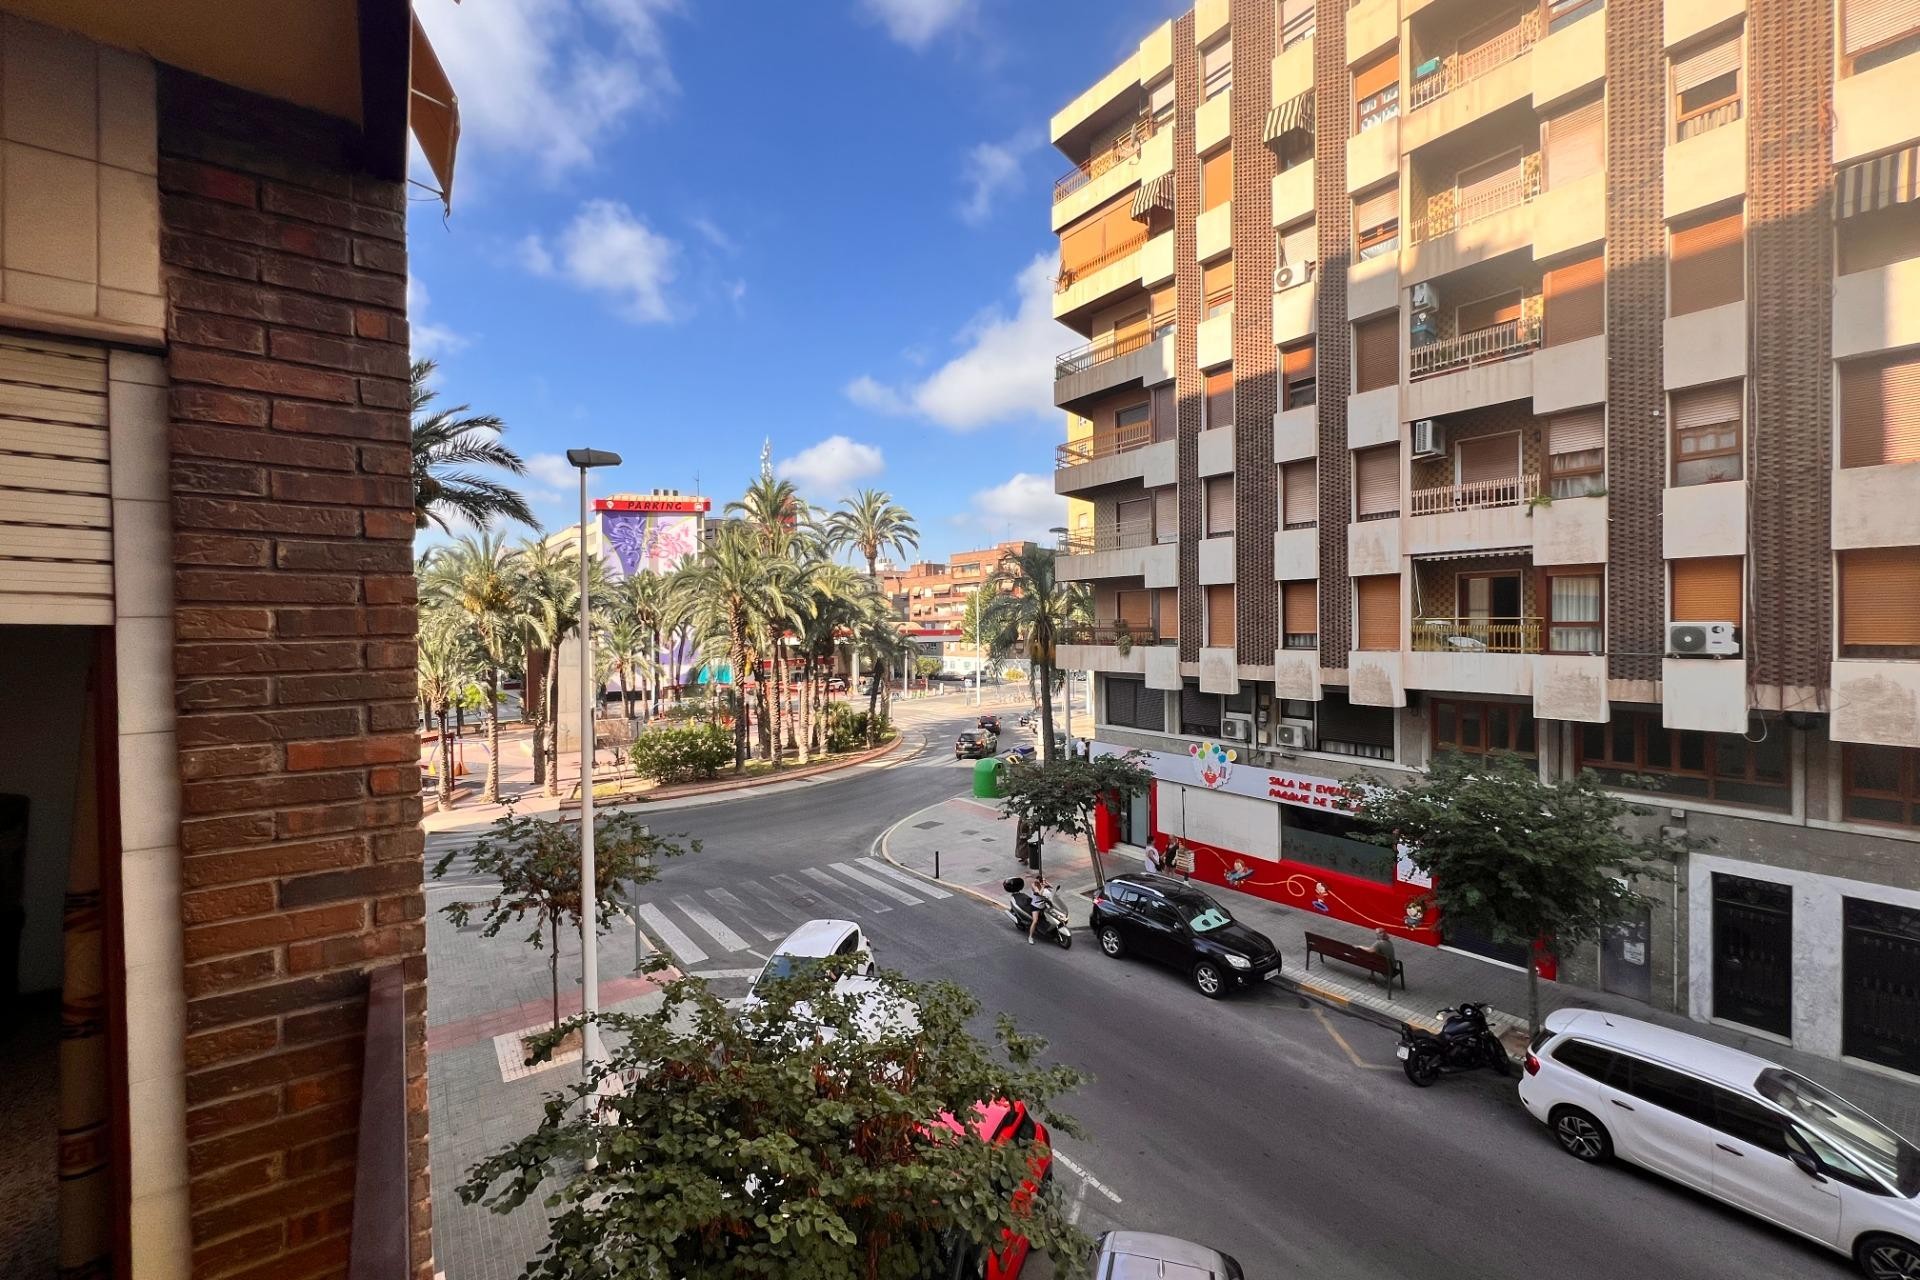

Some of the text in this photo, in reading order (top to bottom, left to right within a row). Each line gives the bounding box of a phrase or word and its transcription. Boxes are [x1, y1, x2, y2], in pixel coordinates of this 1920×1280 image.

[627, 501, 682, 510] PARKING
[1268, 776, 1364, 800] SALA DE EVENT
[1268, 788, 1310, 804] PARQUE
[1313, 795, 1327, 807] DE
